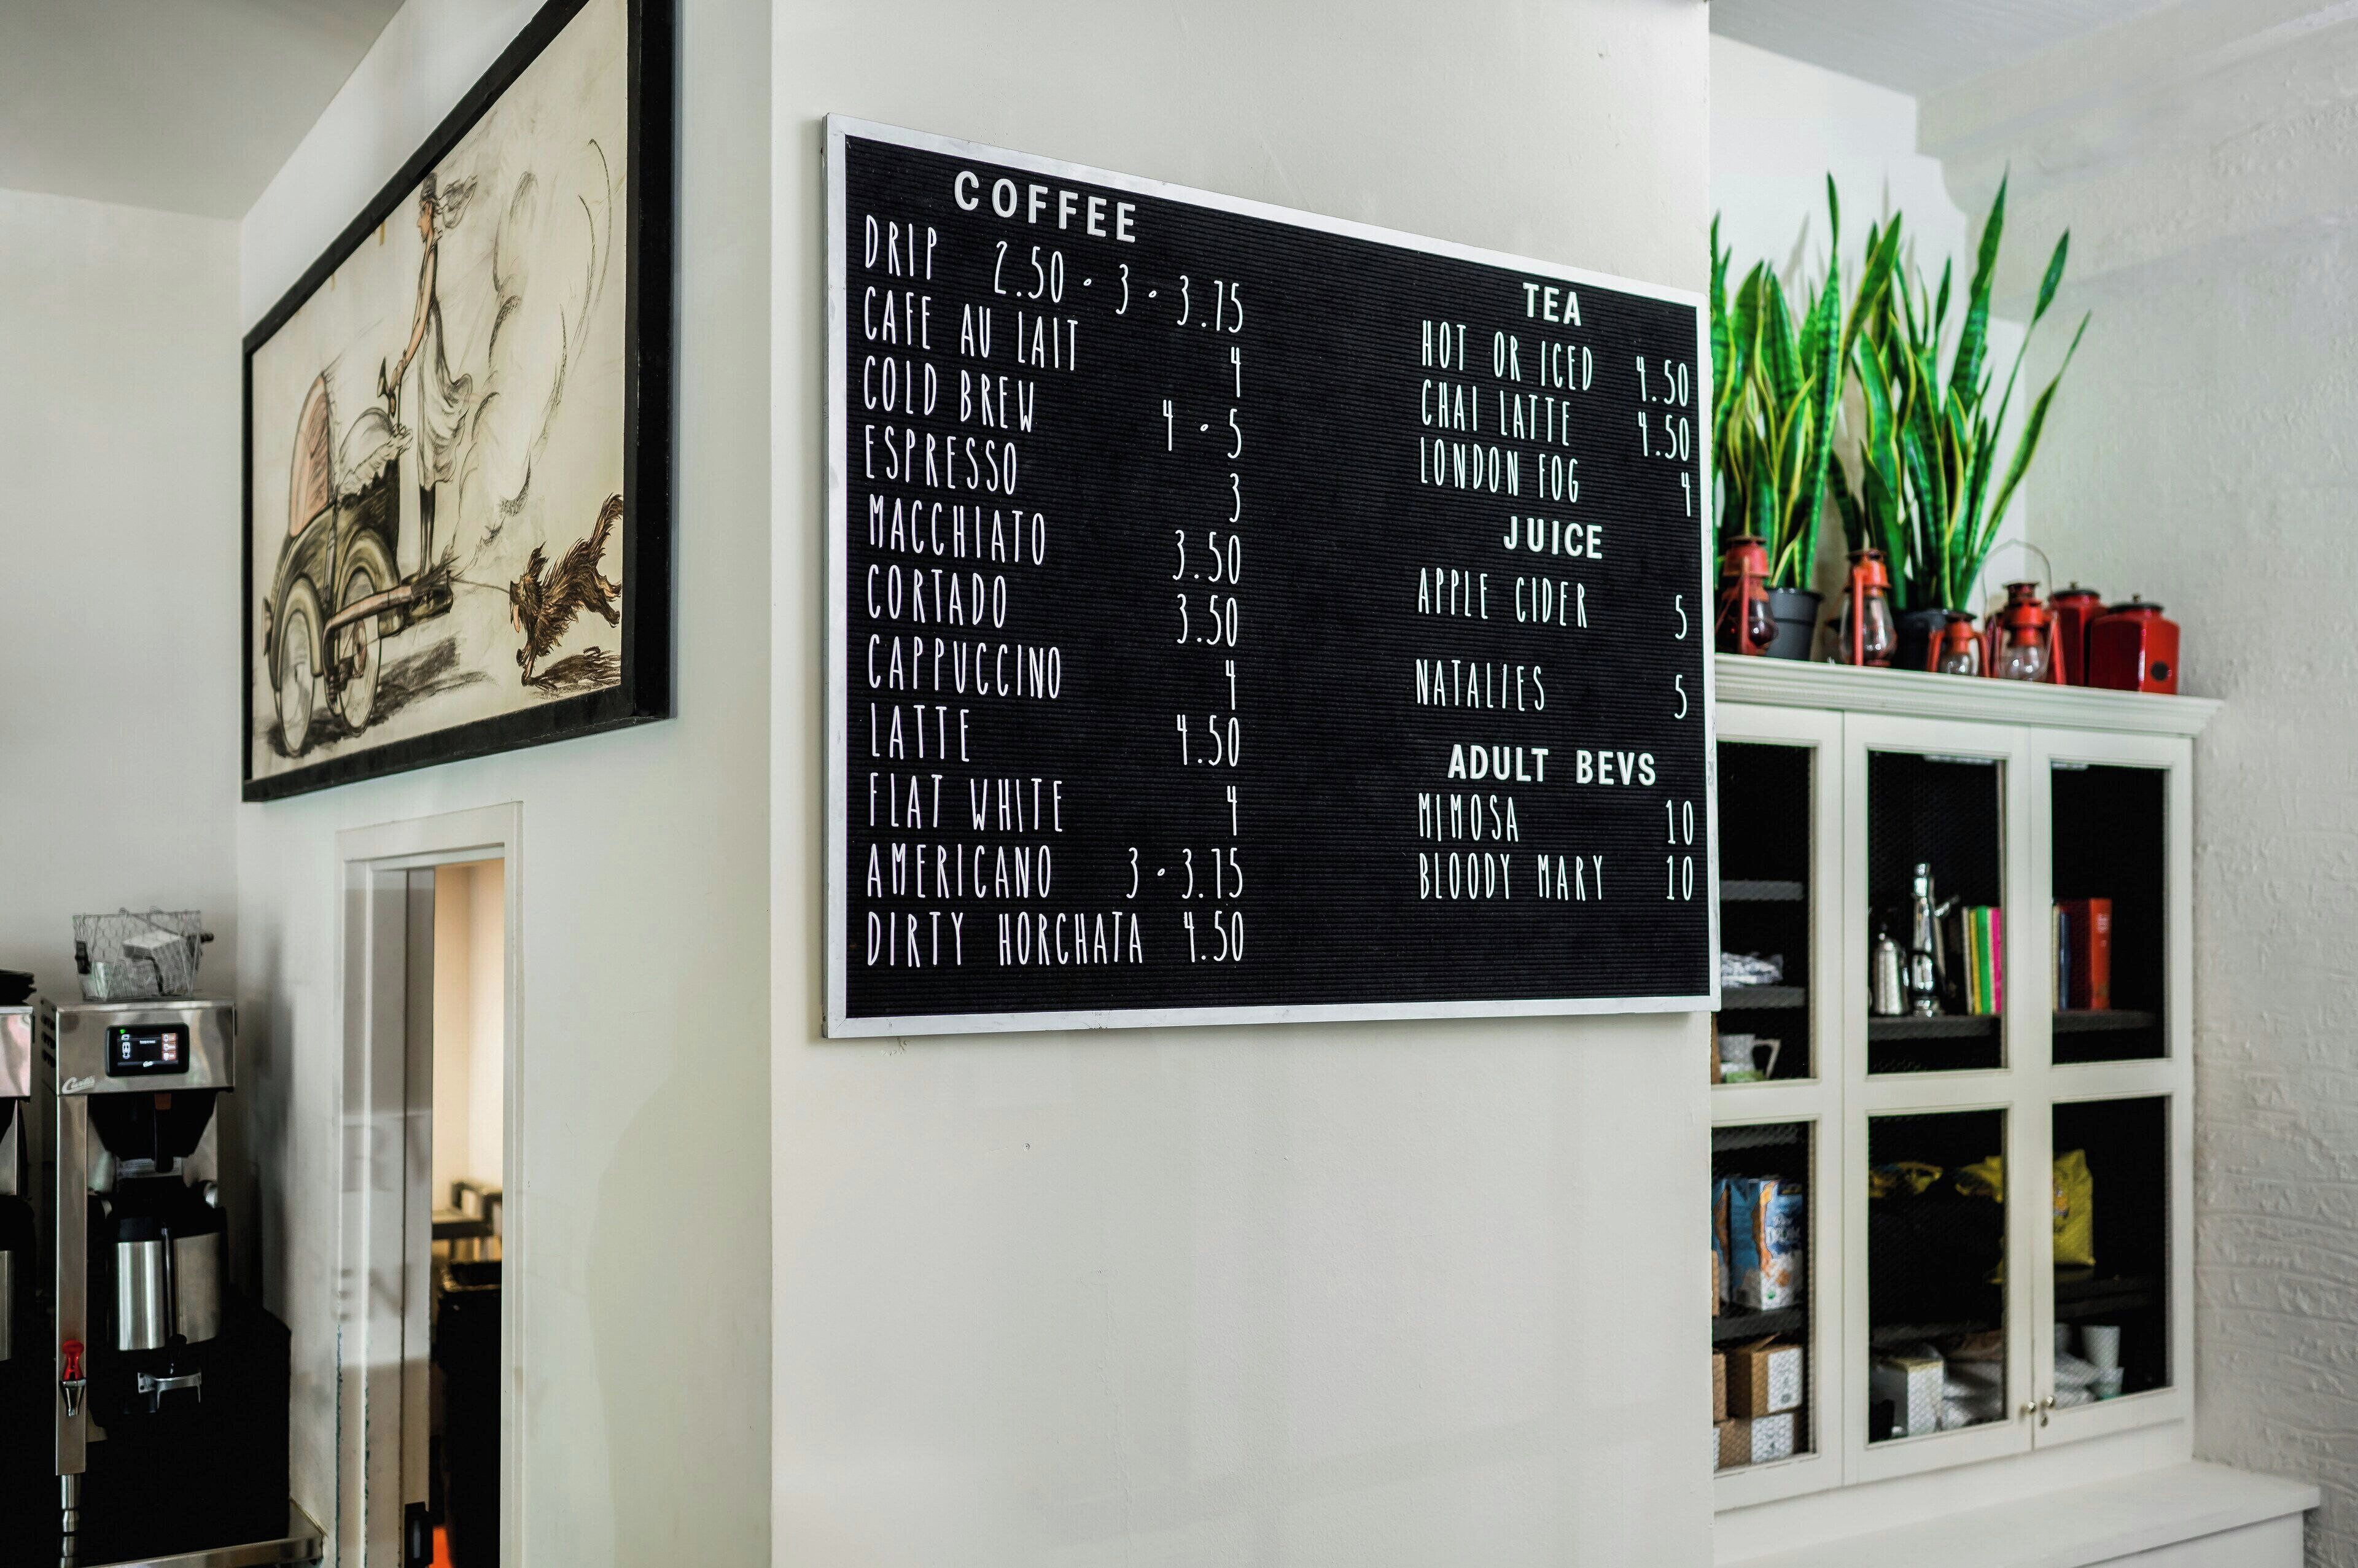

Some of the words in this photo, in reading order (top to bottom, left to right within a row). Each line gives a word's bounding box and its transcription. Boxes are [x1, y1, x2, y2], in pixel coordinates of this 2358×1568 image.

[954, 171, 1135, 243] COFFEE
[865, 214, 937, 280] DRIP
[994, 241, 1064, 303] 2.50
[1115, 263, 1129, 315] 3
[1177, 275, 1243, 333] 3.75
[1522, 282, 1582, 327] TEA
[864, 285, 932, 350] CAFE
[960, 303, 990, 358] AU
[1018, 311, 1078, 371] LAIT
[1231, 346, 1241, 398] 4
[1422, 320, 1466, 371] HOT
[1493, 331, 1521, 382] OR
[1541, 340, 1592, 391] ICED
[1636, 355, 1689, 407] 4.50
[864, 355, 937, 416] COLD
[960, 369, 1034, 433] BREW
[1162, 399, 1173, 451] 4
[1227, 408, 1242, 459] 5
[1422, 378, 1477, 432] CHAI
[1500, 390, 1571, 446] LATTE
[1638, 411, 1690, 462] 4.50
[865, 424, 1017, 495] ESPRESSO
[1229, 473, 1240, 523] 3
[1420, 437, 1519, 496] LONDON
[1539, 453, 1579, 503] FOG
[1681, 472, 1691, 517] 4
[869, 494, 1045, 565] MACCHIATO
[1172, 529, 1241, 584] 3.50
[1503, 516, 1603, 559] JUICE
[868, 564, 1006, 629] CORTADO
[1177, 593, 1238, 647] 3.50
[1418, 567, 1488, 619] APPLE
[1516, 576, 1587, 629] CIDER
[1675, 594, 1687, 640] 5
[868, 634, 1060, 699] CAPPUCCINO
[1225, 659, 1236, 710] 4
[1415, 659, 1544, 712] NATALIES
[1674, 674, 1687, 720] 5
[871, 702, 970, 762] LATTE
[1177, 714, 1240, 767] 4.50
[1447, 743, 1549, 782] ADULT
[1576, 750, 1656, 786] BEVS
[870, 772, 943, 829] FLAT
[970, 778, 1063, 833] WHITE
[1226, 785, 1238, 836] 4
[1418, 793, 1519, 842] MIMOSA
[1665, 799, 1694, 845] 10
[867, 842, 1051, 899] AMERICANO
[1126, 847, 1138, 899] 3
[1181, 847, 1243, 899] 3.75
[1419, 852, 1510, 900] BLOODY
[1538, 854, 1603, 901] MARY
[1666, 855, 1693, 901] 10
[867, 911, 963, 968] DIRTY
[998, 911, 1143, 966] HORCHATA
[1183, 910, 1243, 963] 4.50
